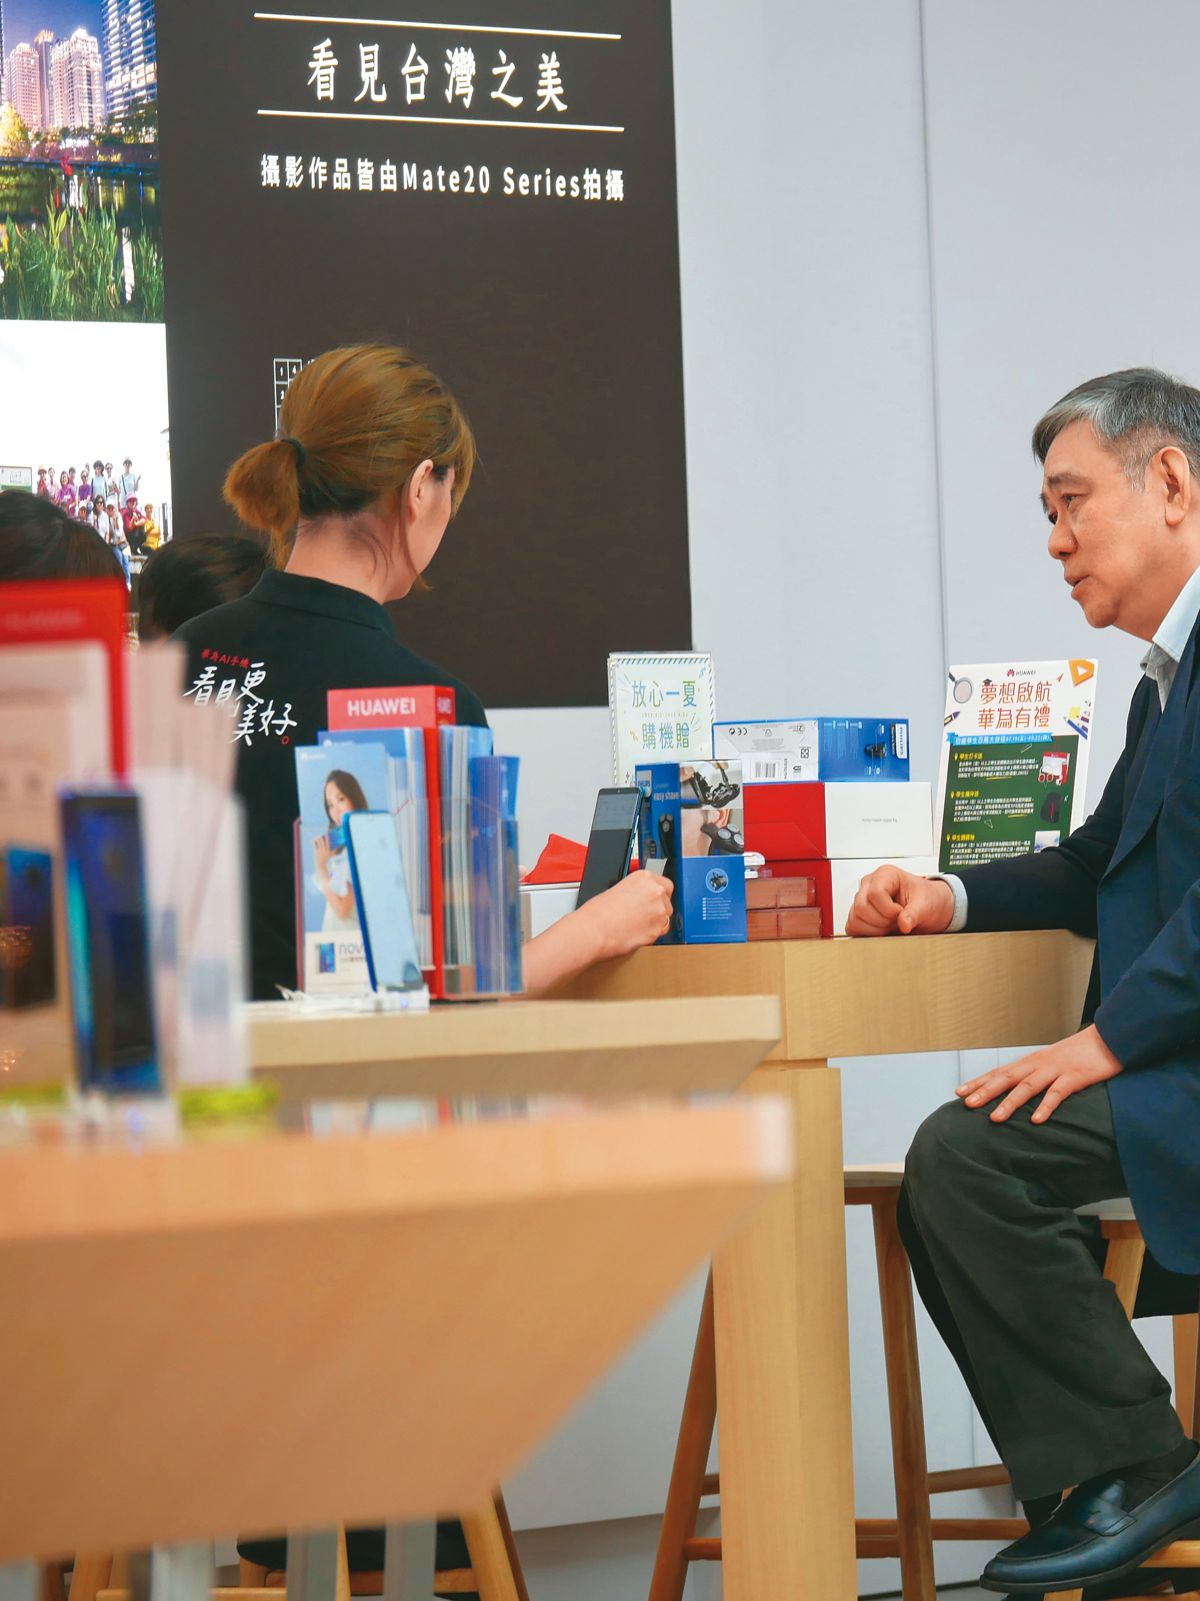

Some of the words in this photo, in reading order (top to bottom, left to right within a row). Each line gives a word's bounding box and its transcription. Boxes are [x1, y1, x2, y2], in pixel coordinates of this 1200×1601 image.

[307, 37, 568, 112] 看見台灣之美
[261, 154, 490, 194] 攝影作品皆由Mate20
[503, 166, 625, 201] Series拍攝
[346, 696, 416, 717] HUAWEI
[631, 680, 697, 708] 放心一夏
[977, 703, 1051, 730] 華為有禮
[641, 722, 690, 750] 購機贈
